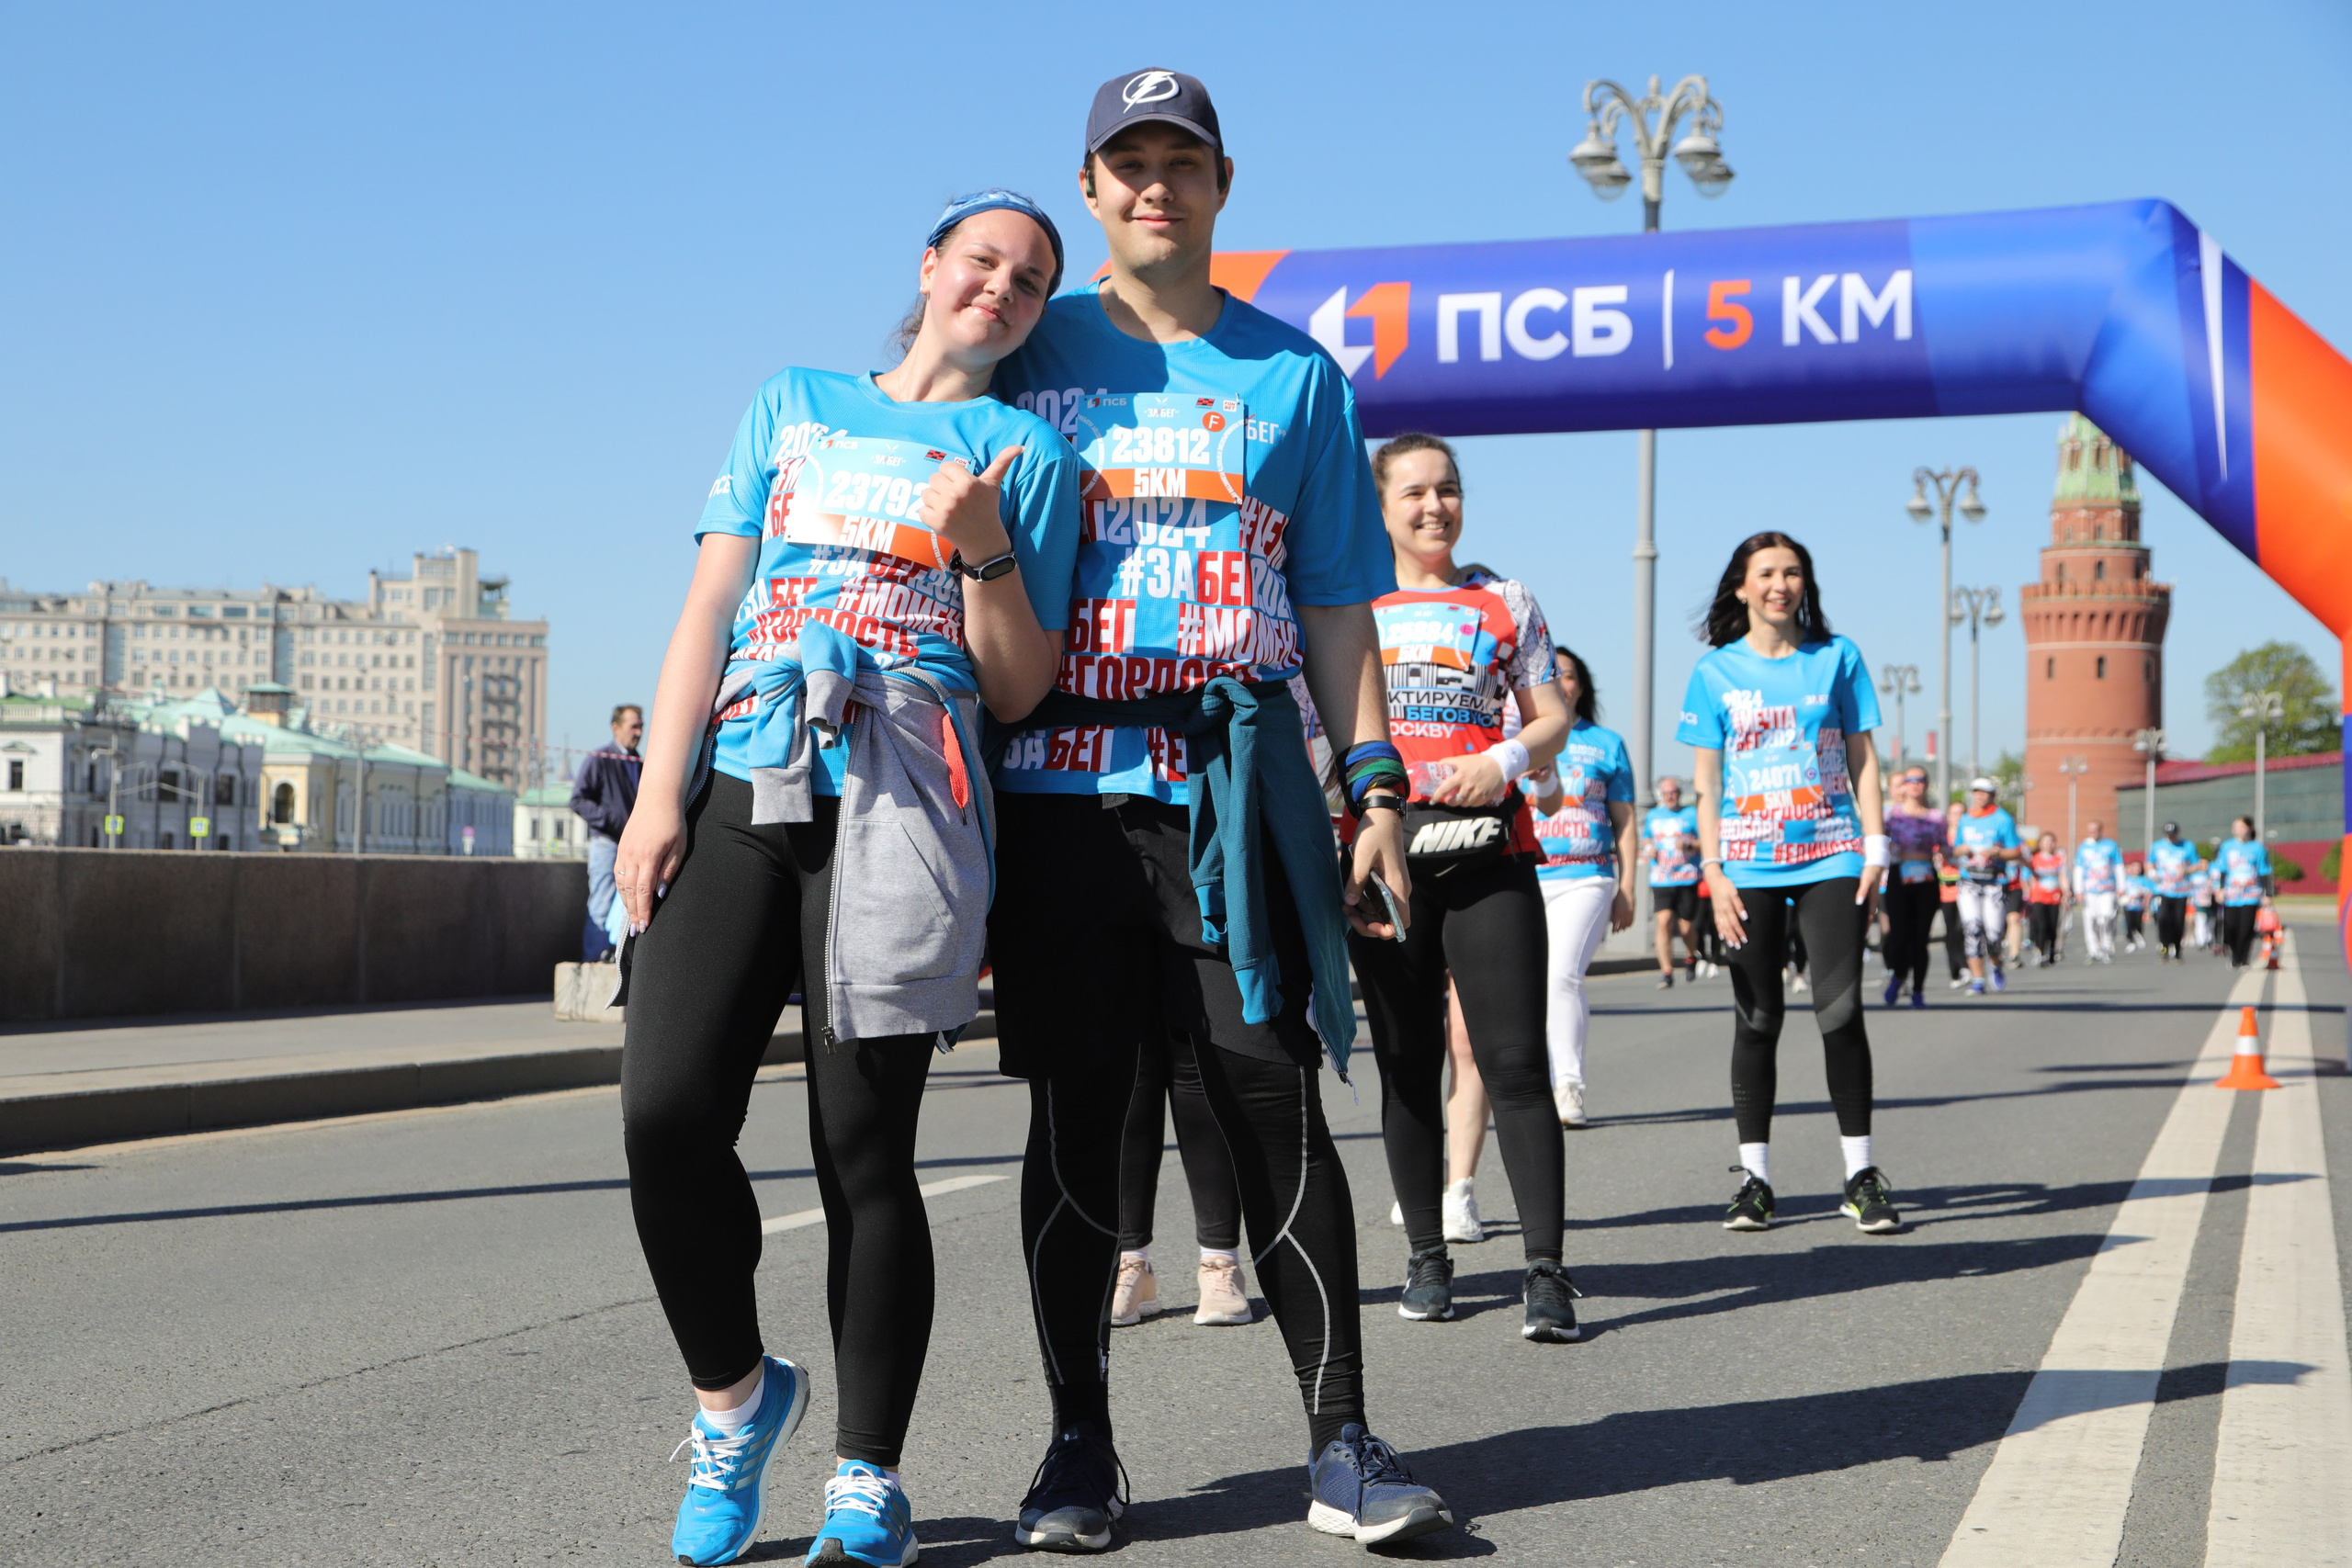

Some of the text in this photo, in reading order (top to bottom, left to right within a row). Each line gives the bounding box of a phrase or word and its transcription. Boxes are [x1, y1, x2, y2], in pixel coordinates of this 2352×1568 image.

[1437, 269, 1913, 364] ПСБ 5 КМ
[1017, 387, 1107, 434] 02
[1102, 397, 1127, 407] ПСБ
[1208, 414, 1220, 429] F
[834, 440, 858, 450] ПСБ
[1111, 426, 1211, 465] 23812
[1133, 468, 1187, 498] 5КМ
[839, 515, 898, 554] 5КМ
[1722, 689, 1764, 709] 2024
[1748, 762, 1802, 792] 24071
[1408, 816, 1503, 854] NIKE
